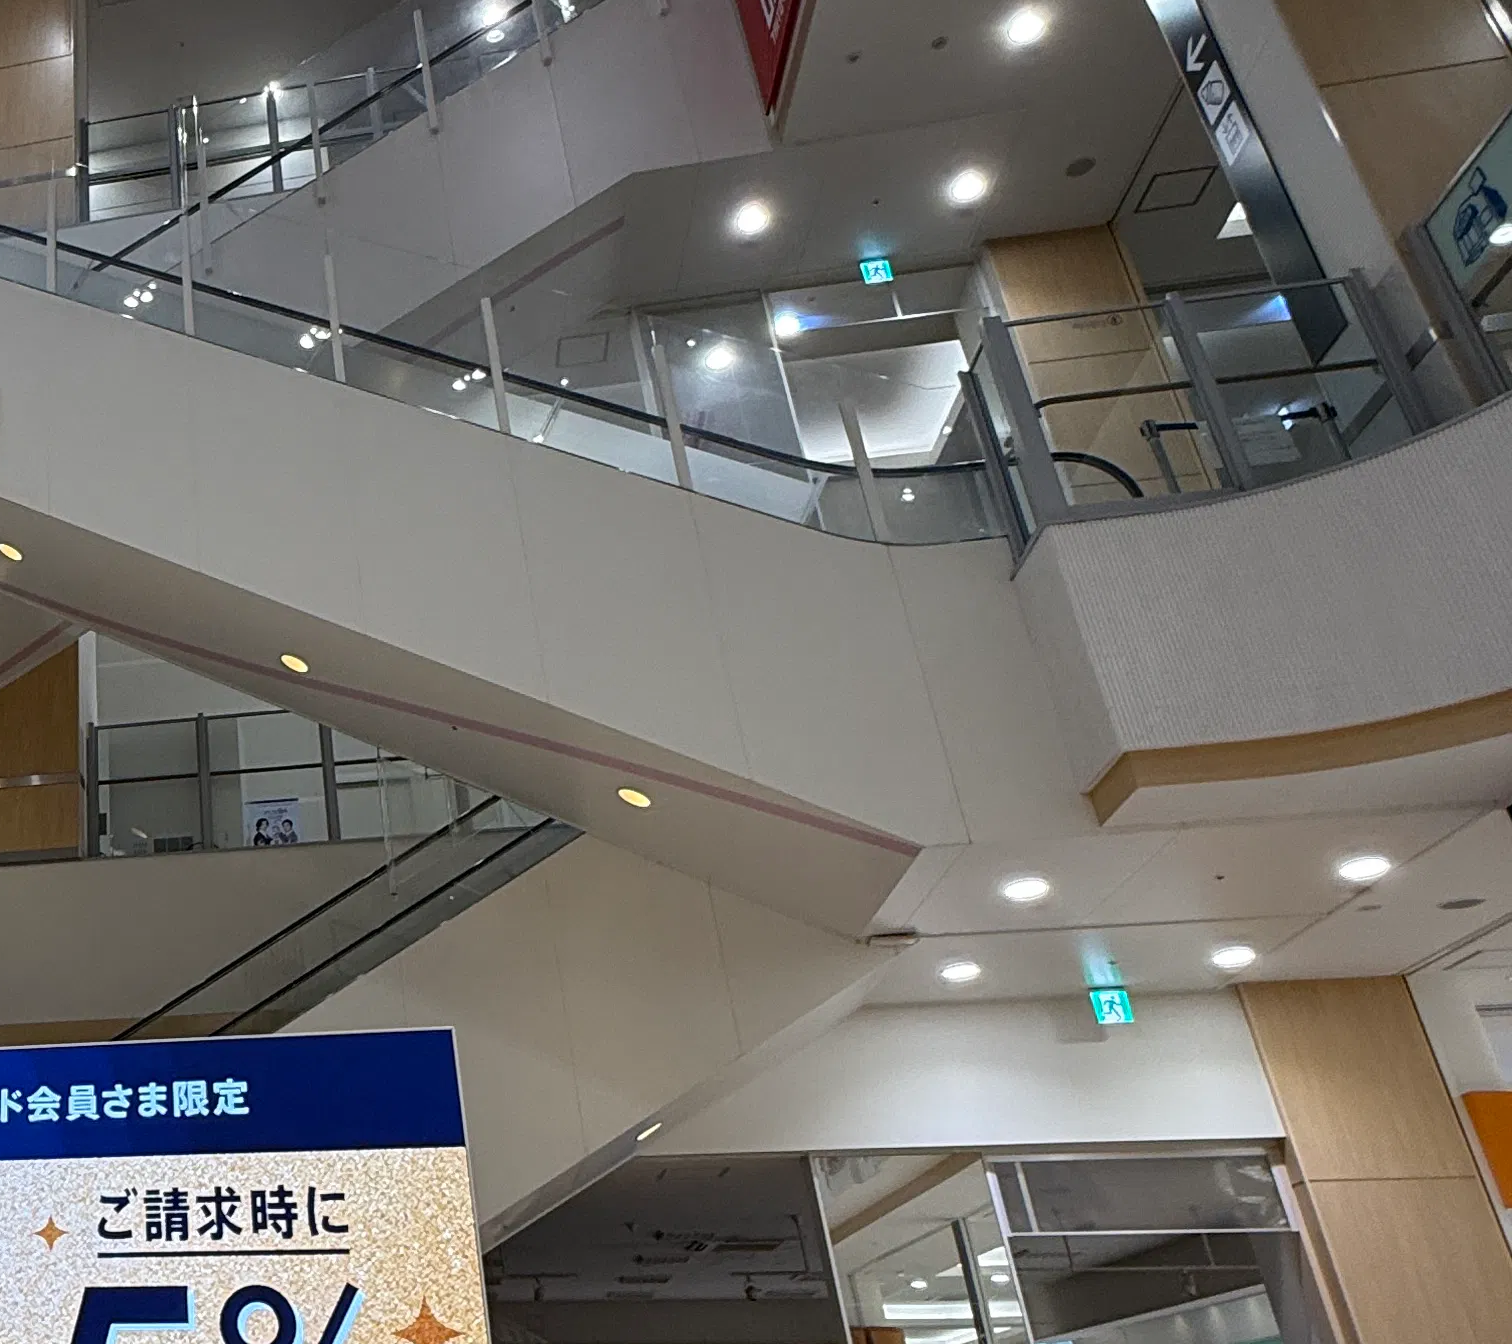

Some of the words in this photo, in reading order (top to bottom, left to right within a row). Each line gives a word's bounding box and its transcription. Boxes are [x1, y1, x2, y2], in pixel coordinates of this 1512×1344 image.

[97, 1184, 350, 1242] ご請求時に
